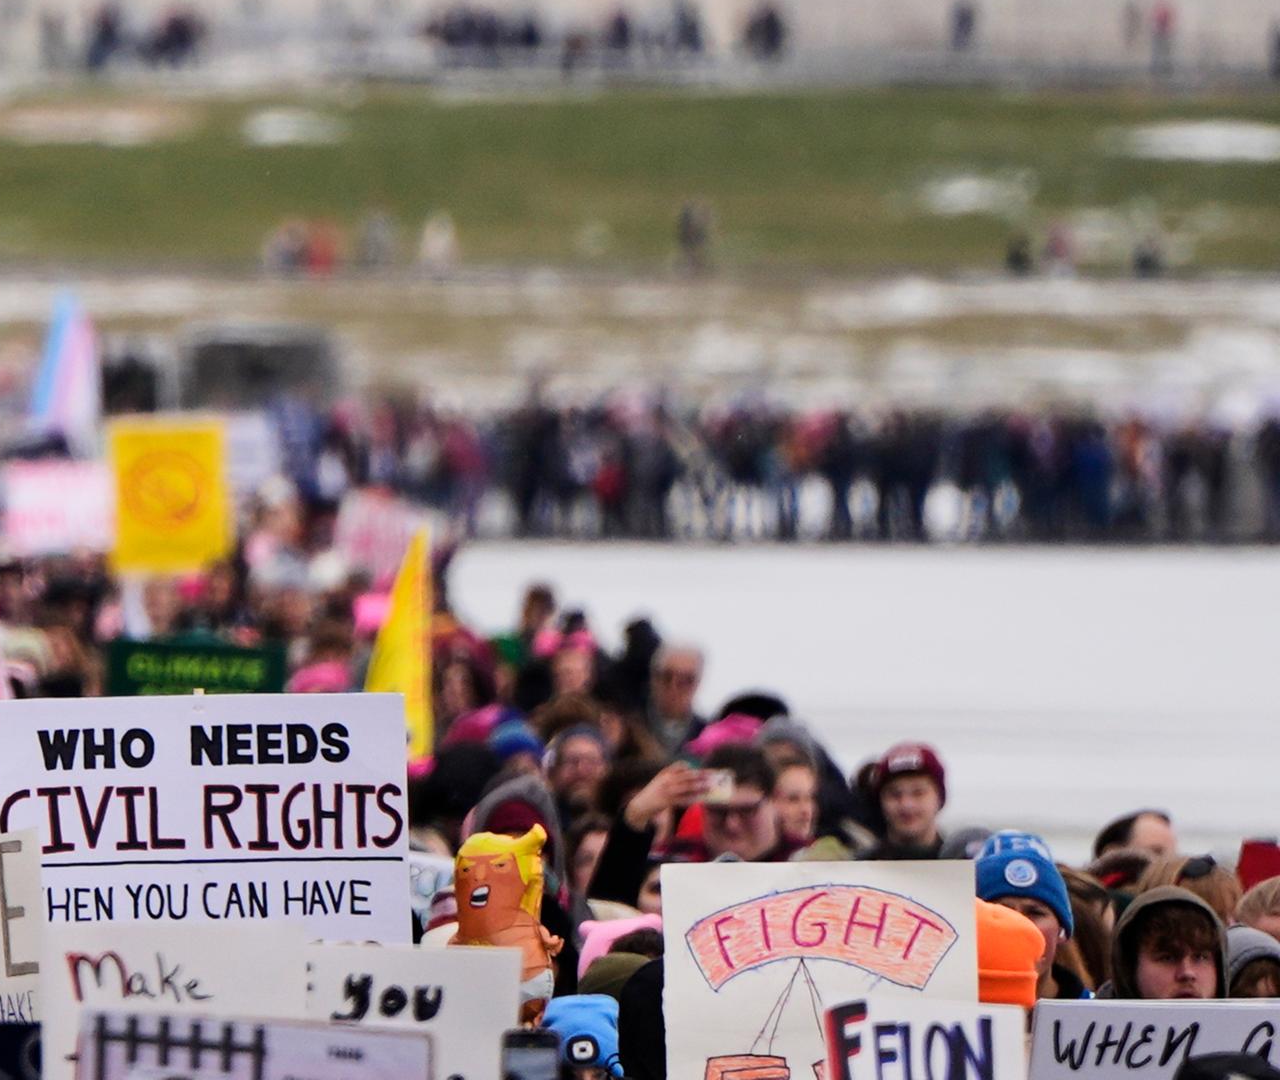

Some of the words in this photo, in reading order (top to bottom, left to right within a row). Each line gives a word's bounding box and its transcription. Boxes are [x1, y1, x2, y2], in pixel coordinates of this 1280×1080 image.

[37, 726, 156, 771] WHO
[190, 722, 351, 766] NEEDS
[0, 784, 187, 854] CIVIL
[203, 782, 404, 851] RIGHTS
[41, 885, 115, 922] HEN
[126, 882, 189, 920] YOU
[202, 880, 268, 919] CAN
[283, 878, 372, 917] HAVE
[713, 891, 945, 971] FIGHT
[66, 949, 214, 1002] Make
